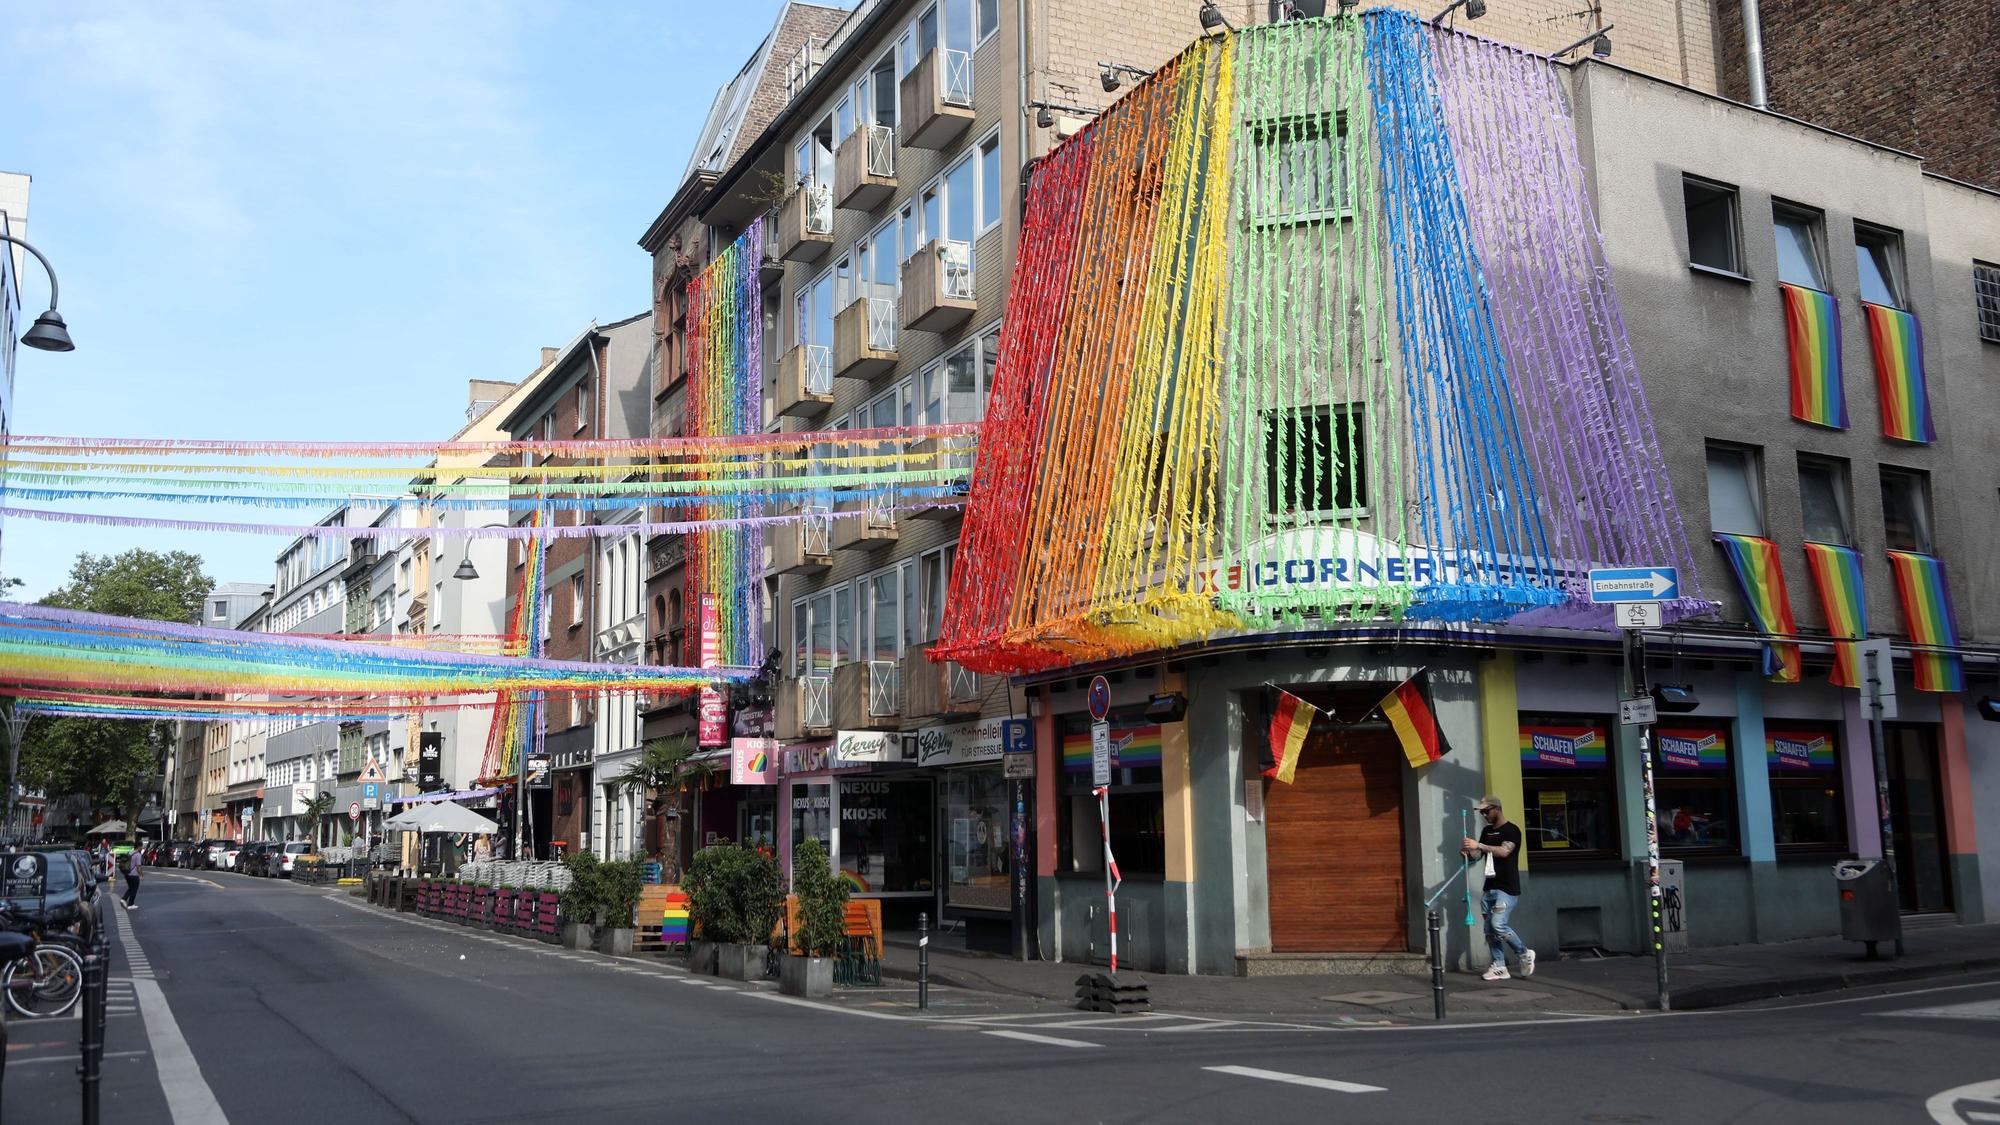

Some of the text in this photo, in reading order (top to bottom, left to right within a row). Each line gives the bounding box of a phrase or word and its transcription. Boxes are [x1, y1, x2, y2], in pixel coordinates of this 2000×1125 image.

[1255, 557, 1436, 586] CORNER
[1596, 580, 1654, 591] Einbahnstraße
[747, 740, 776, 749] KIOSK
[1010, 724, 1025, 749] P
[1533, 732, 1594, 755] SCHAAFEN STRASSE
[973, 744, 1002, 757] STRESSLIE
[1661, 738, 1697, 756] SCHAAFEN
[1775, 740, 1808, 758] SCHAAFEN
[736, 750, 744, 783] NEXUS
[784, 747, 819, 774] NEXUS
[840, 782, 890, 794] NEXUS
[793, 797, 829, 809] NEXUS KIOSK
[842, 808, 887, 820] KIOSK
